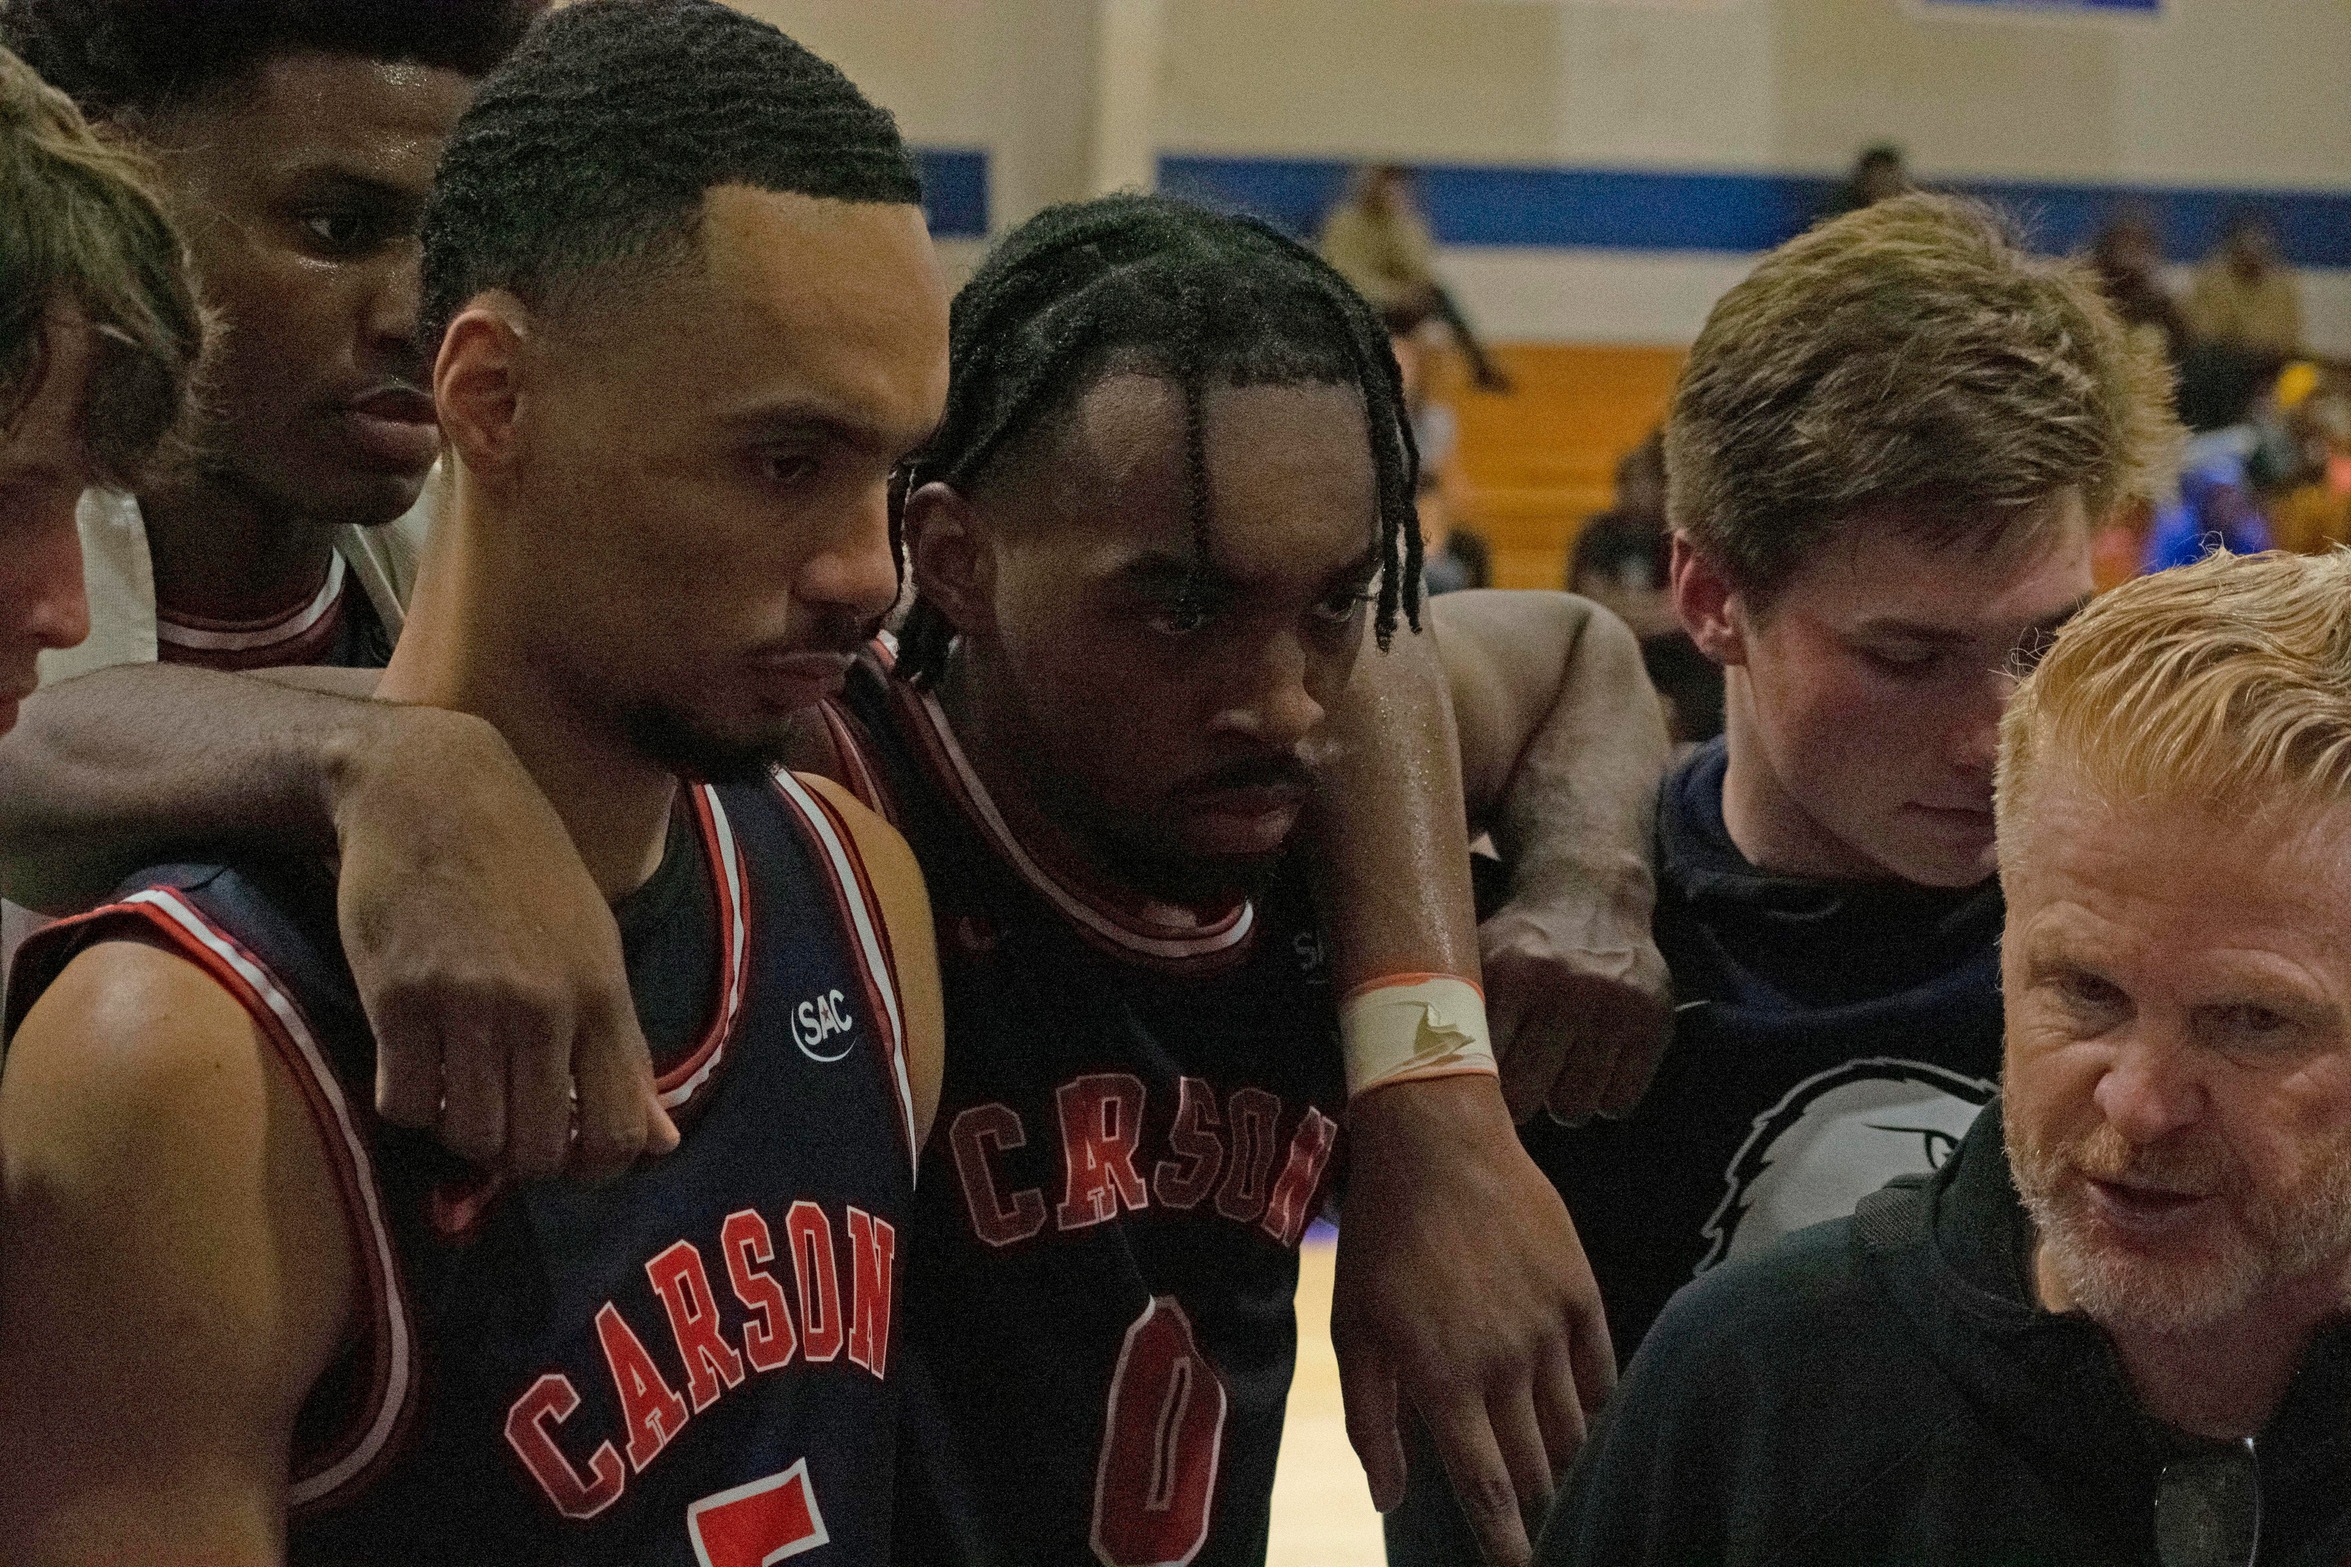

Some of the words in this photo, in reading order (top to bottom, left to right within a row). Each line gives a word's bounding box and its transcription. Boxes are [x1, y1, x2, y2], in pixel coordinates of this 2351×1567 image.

[798, 989, 852, 1046] SAC
[504, 1200, 896, 1519] CARSON
[1088, 1293, 1228, 1567] 0
